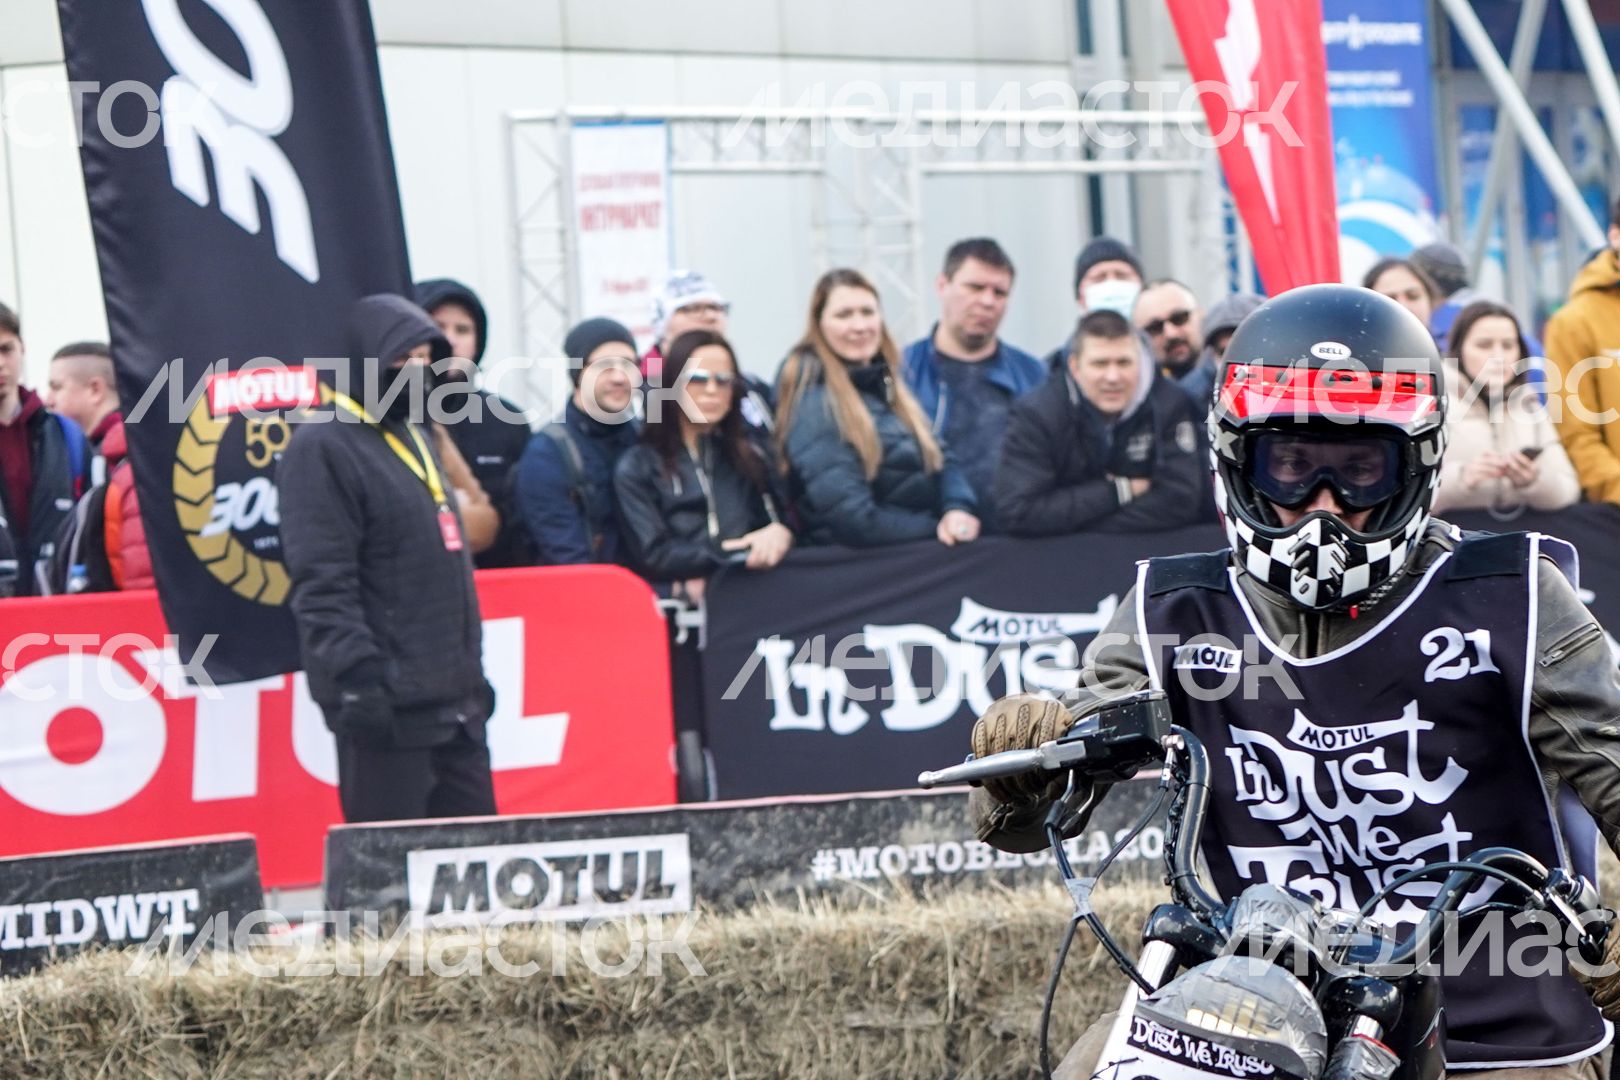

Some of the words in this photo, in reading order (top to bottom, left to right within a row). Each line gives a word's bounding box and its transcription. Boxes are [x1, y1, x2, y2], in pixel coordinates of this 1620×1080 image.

[1319, 347, 1343, 356] BELL
[213, 371, 315, 409] MOTUL
[245, 416, 291, 468] 50
[968, 615, 1065, 636] MOTUL
[1420, 627, 1501, 683] 21
[1300, 726, 1374, 749] MOTUL
[424, 848, 677, 915] MOTUL
